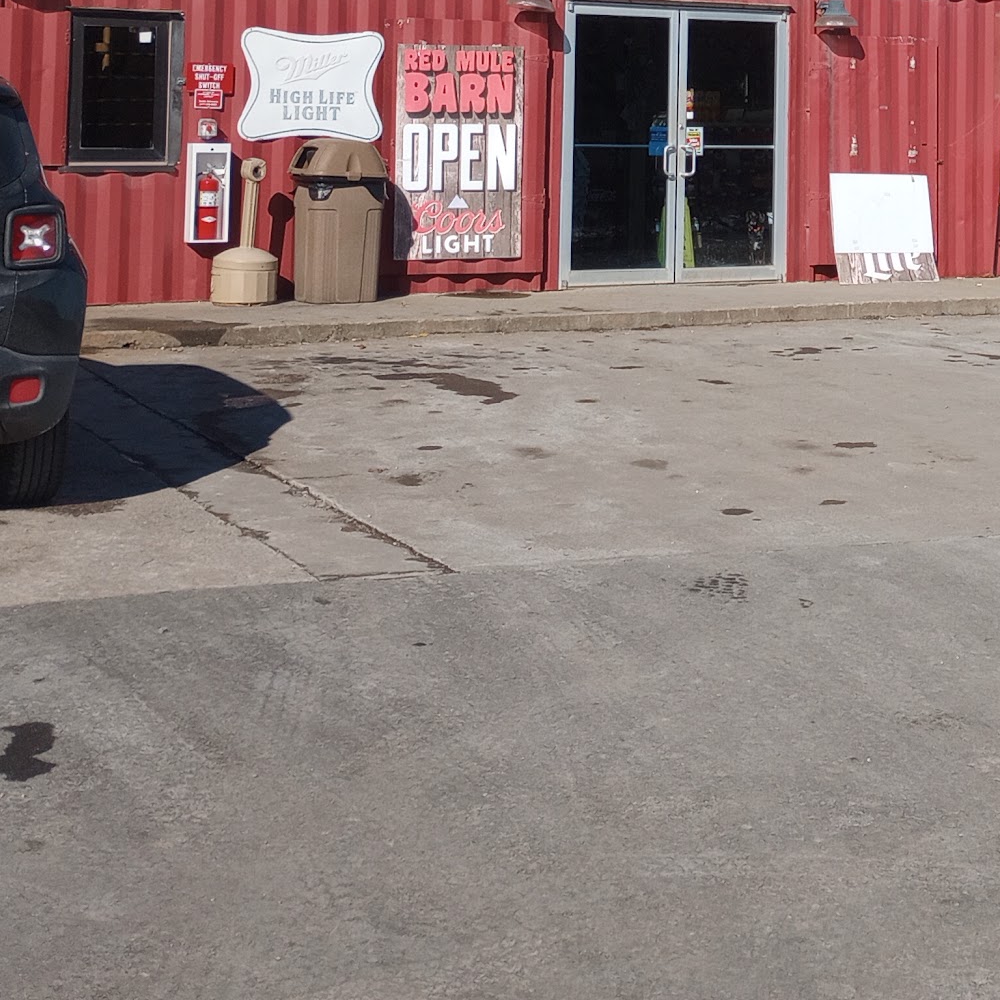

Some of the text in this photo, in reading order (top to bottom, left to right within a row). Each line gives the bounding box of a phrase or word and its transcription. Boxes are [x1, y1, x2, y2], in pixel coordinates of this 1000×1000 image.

[192, 64, 227, 72] EMERGENCY
[275, 52, 348, 81] Miller
[404, 49, 515, 73] RED MULE
[194, 73, 224, 81] SHUT-OFF
[269, 88, 355, 105] HIGH LIFE
[404, 72, 515, 116] BARN
[282, 105, 341, 121] LIGHT
[402, 123, 518, 191] OPEN
[411, 200, 506, 235] Coors
[421, 234, 495, 254] LIGHT
